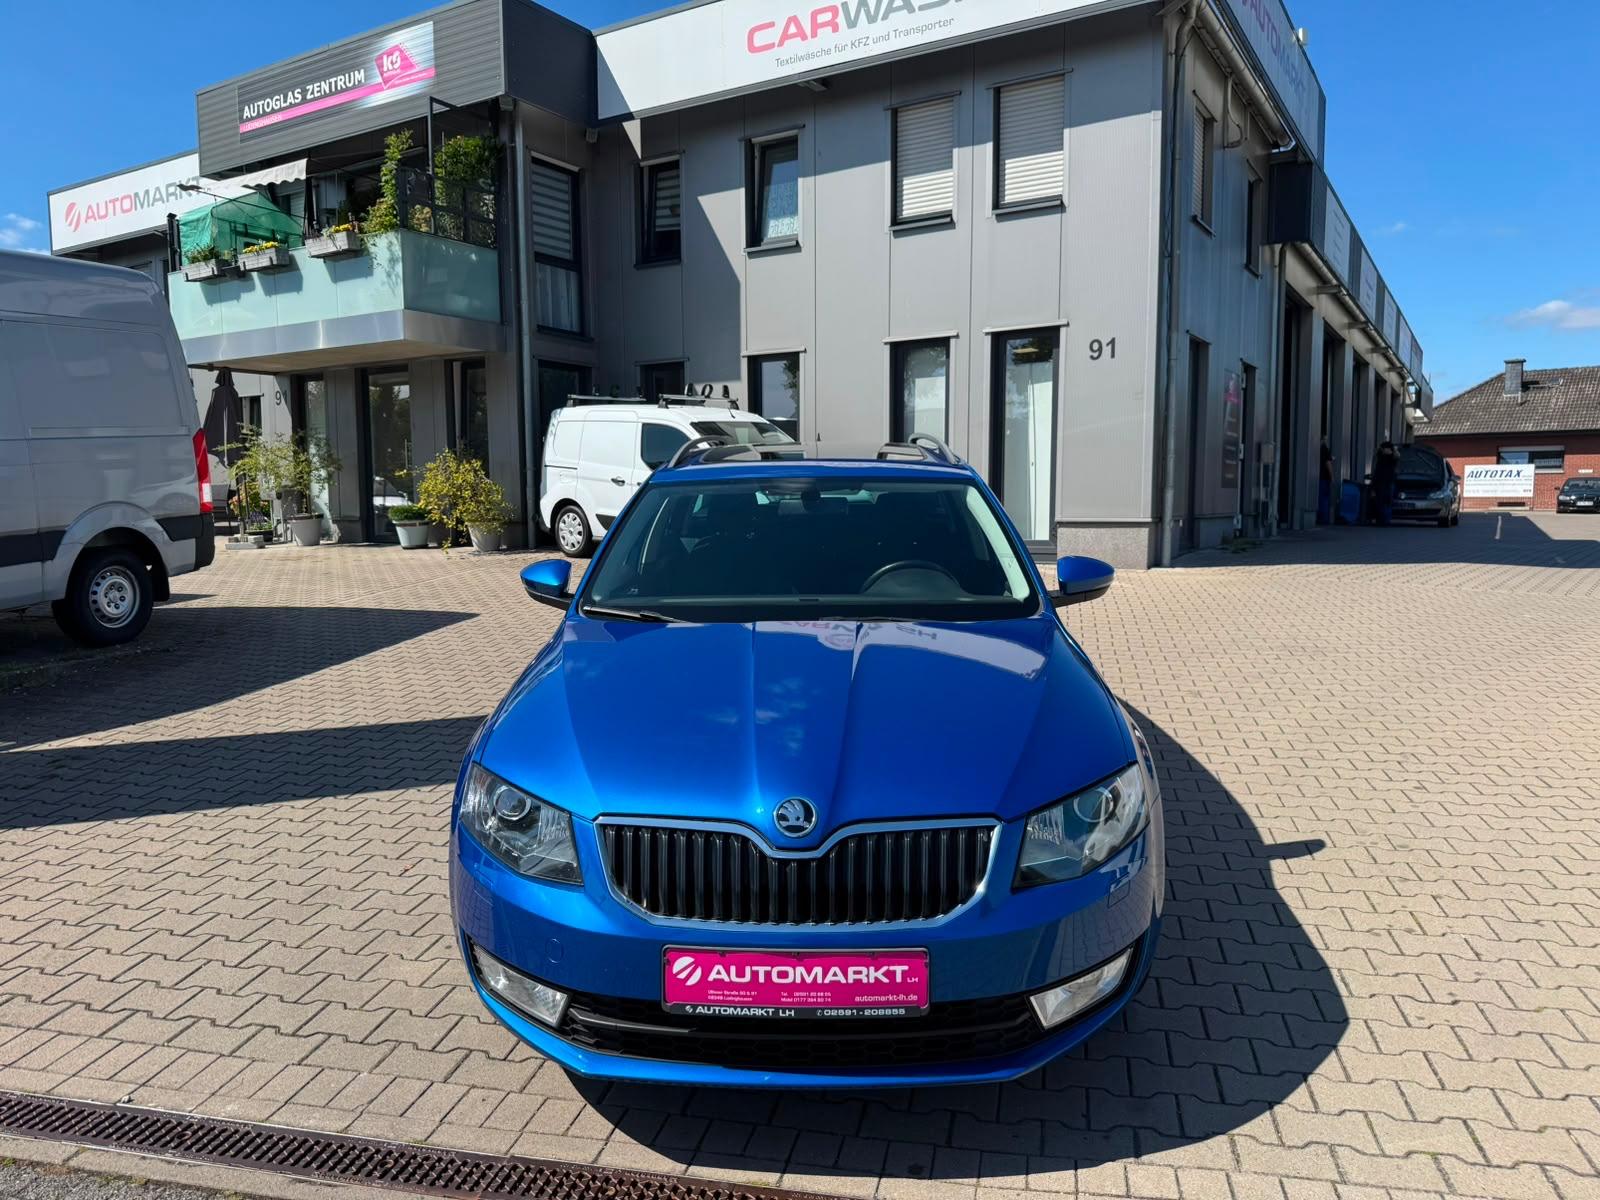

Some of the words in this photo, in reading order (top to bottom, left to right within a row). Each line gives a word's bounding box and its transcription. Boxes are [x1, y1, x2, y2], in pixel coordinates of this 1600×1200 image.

[775, 48, 832, 68] Textilwäsche
[834, 41, 848, 54] für
[850, 36, 870, 49] KFZ
[872, 31, 890, 45] und
[893, 17, 954, 39] Transporter
[243, 90, 302, 119] AUTOGLAS
[306, 69, 365, 100] ZENTRUM
[1089, 337, 1116, 361] 91
[1467, 469, 1523, 479] AUTOTAX
[707, 964, 909, 984] AUTOMARKT
[854, 993, 918, 1002] automarkt-lh.de
[695, 1005, 775, 1016] AUTOMARKT
[779, 1009, 795, 1017] LH
